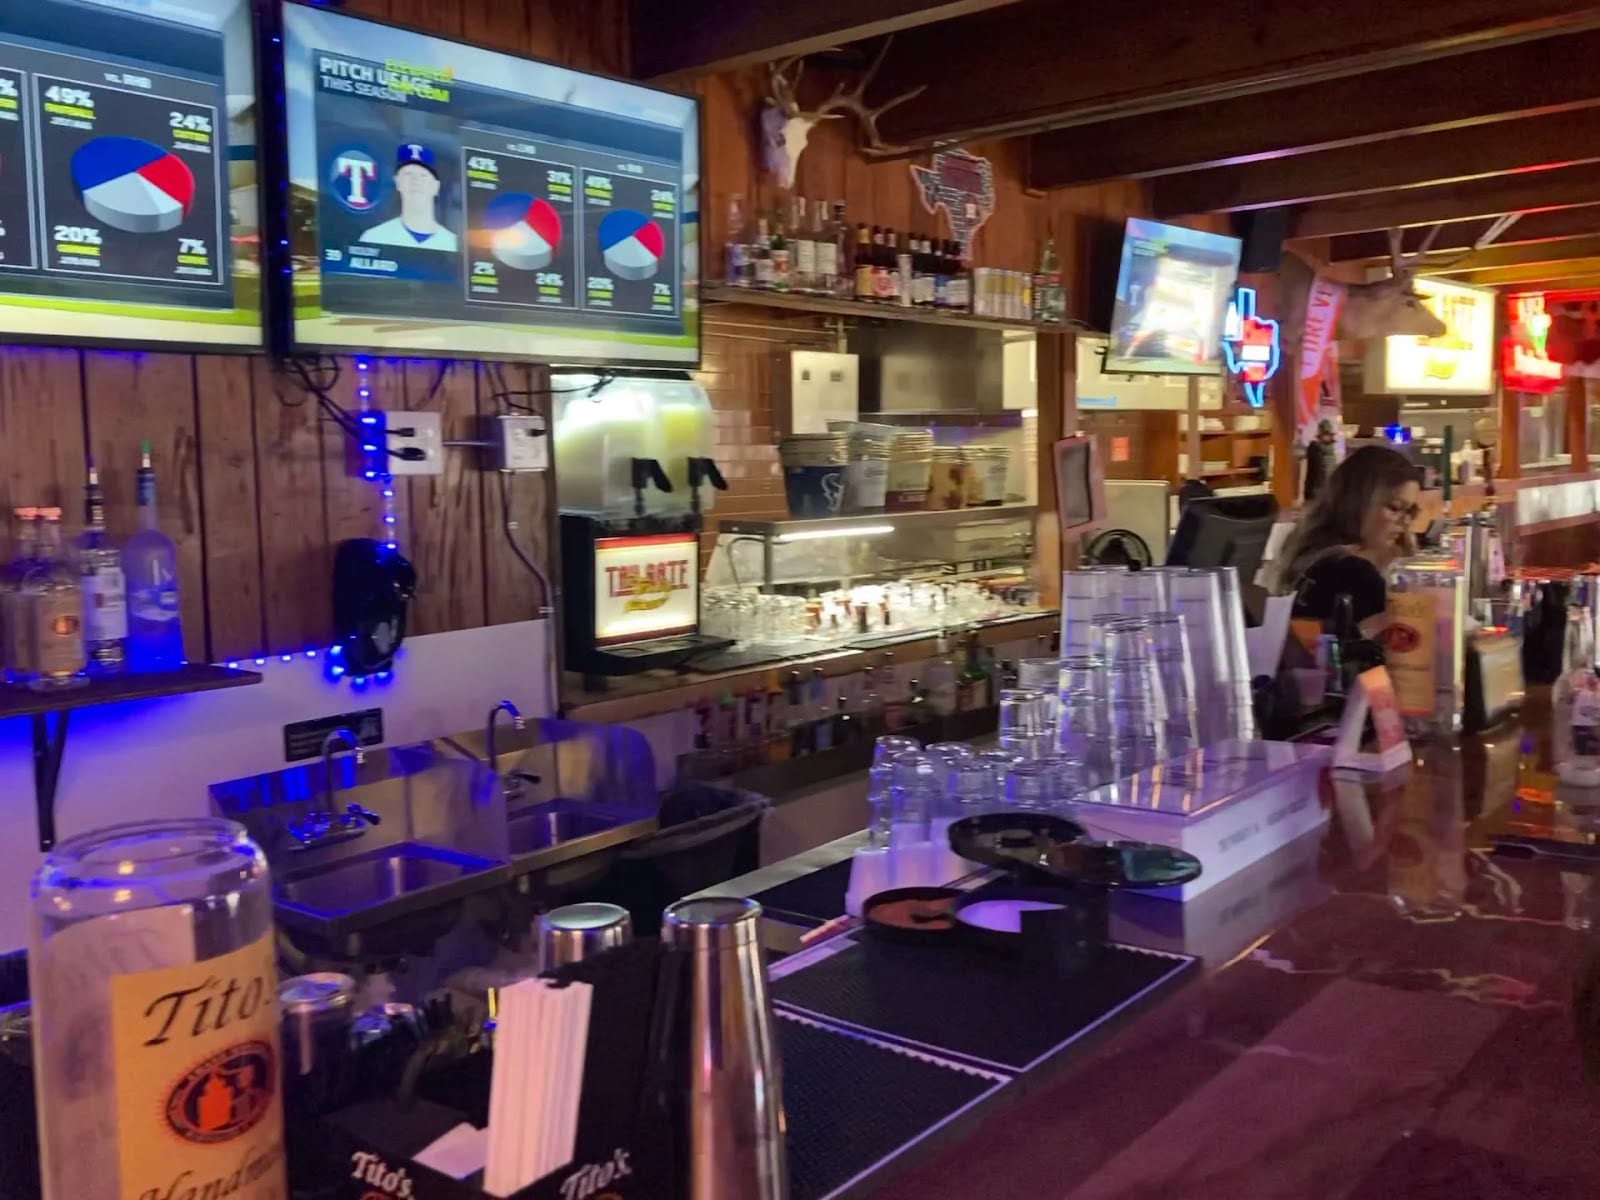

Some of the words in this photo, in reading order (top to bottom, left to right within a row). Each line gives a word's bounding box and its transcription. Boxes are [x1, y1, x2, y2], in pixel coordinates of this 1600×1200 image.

[319, 57, 374, 82] PITCH
[45, 86, 94, 108] 49%
[169, 111, 212, 132] 24%
[54, 225, 102, 245] 20%
[178, 238, 207, 255] 7%
[351, 1151, 413, 1198] Tito's
